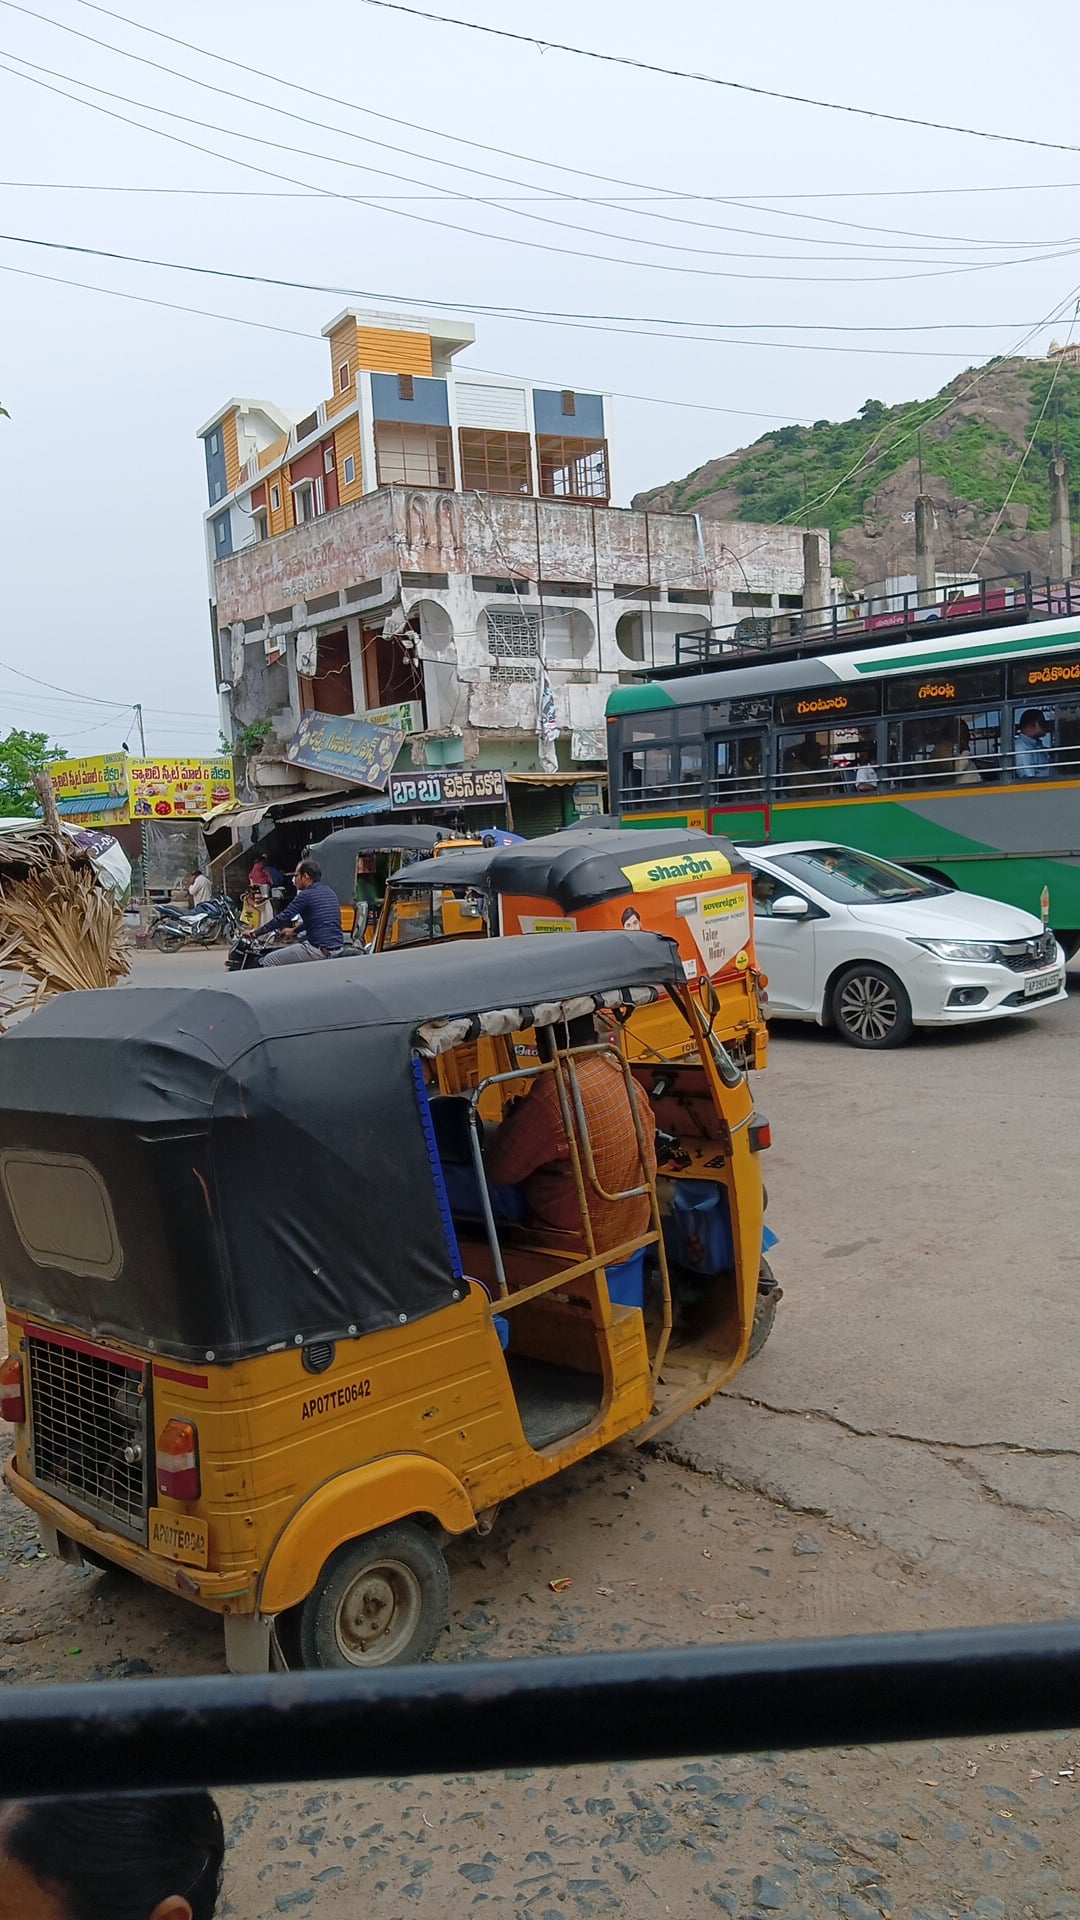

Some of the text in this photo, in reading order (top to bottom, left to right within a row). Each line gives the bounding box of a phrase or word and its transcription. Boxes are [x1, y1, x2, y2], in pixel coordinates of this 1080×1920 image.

[918, 683, 955, 699] గోరంట్ల
[797, 696, 848, 714] గుంటూరు
[443, 772, 475, 798] చికెన్
[647, 856, 713, 882] sharon
[703, 896, 738, 912] sovereign
[702, 928, 719, 942] Value
[708, 946, 726, 960] Money
[302, 1379, 371, 1421] AP07TE0642
